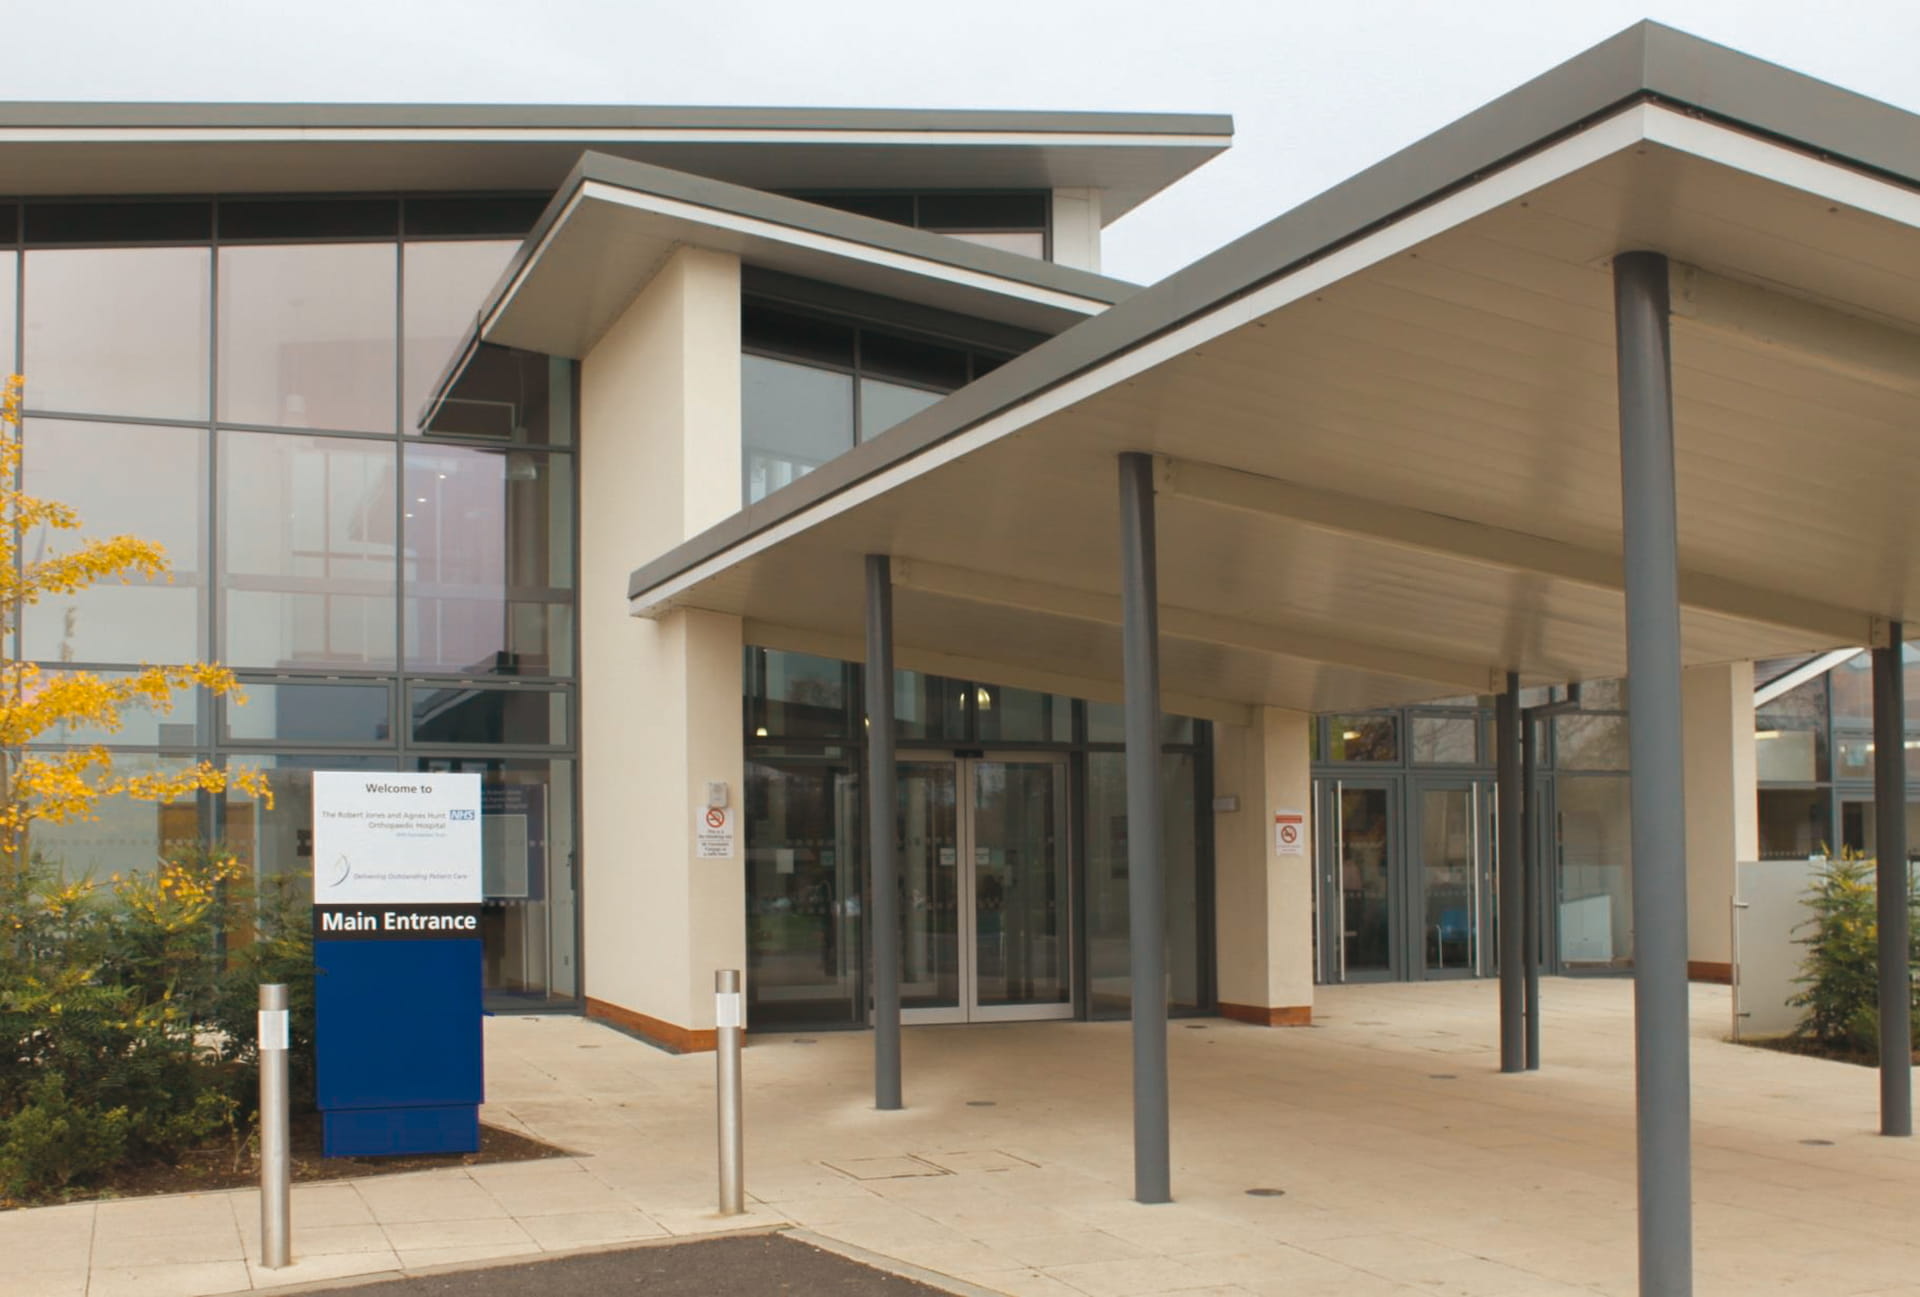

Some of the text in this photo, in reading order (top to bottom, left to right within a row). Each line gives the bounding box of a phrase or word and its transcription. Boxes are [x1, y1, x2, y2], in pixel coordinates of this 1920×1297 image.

[365, 783, 432, 794] Welcome to
[337, 811, 363, 819] Robert
[365, 812, 385, 820] Jones
[450, 810, 474, 820] NHS
[415, 821, 446, 830] Hospital
[322, 911, 477, 931] Main Entrance
